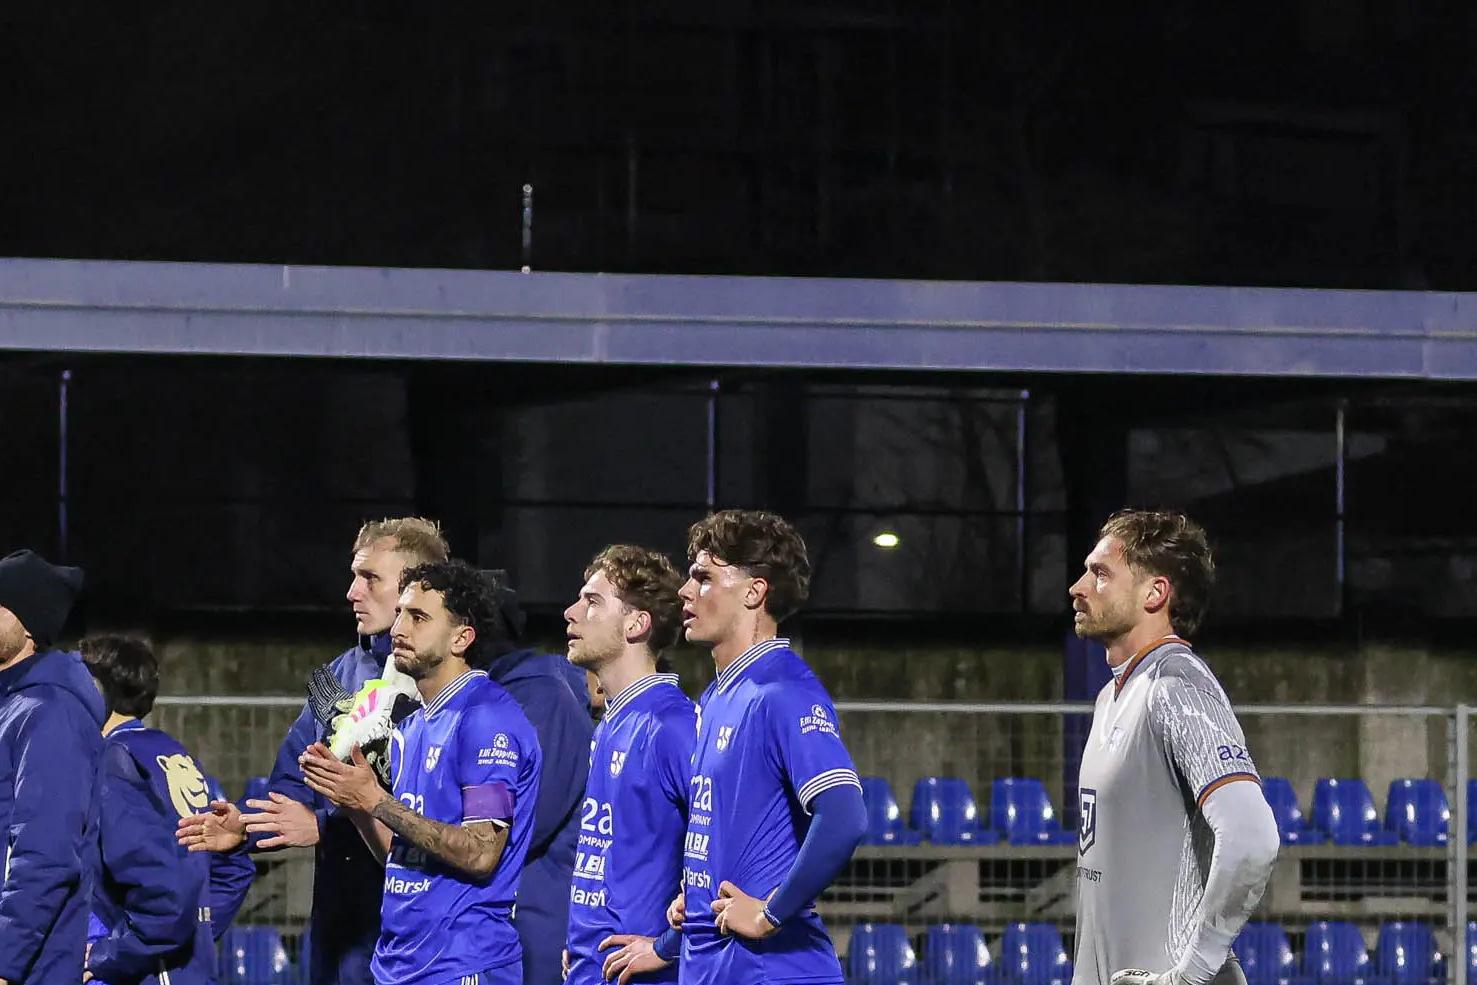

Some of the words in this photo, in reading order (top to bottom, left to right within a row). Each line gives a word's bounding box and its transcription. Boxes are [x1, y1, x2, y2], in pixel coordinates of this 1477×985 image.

[1217, 744, 1248, 761] a2
[691, 774, 713, 812] 2a
[581, 797, 614, 836] 2a
